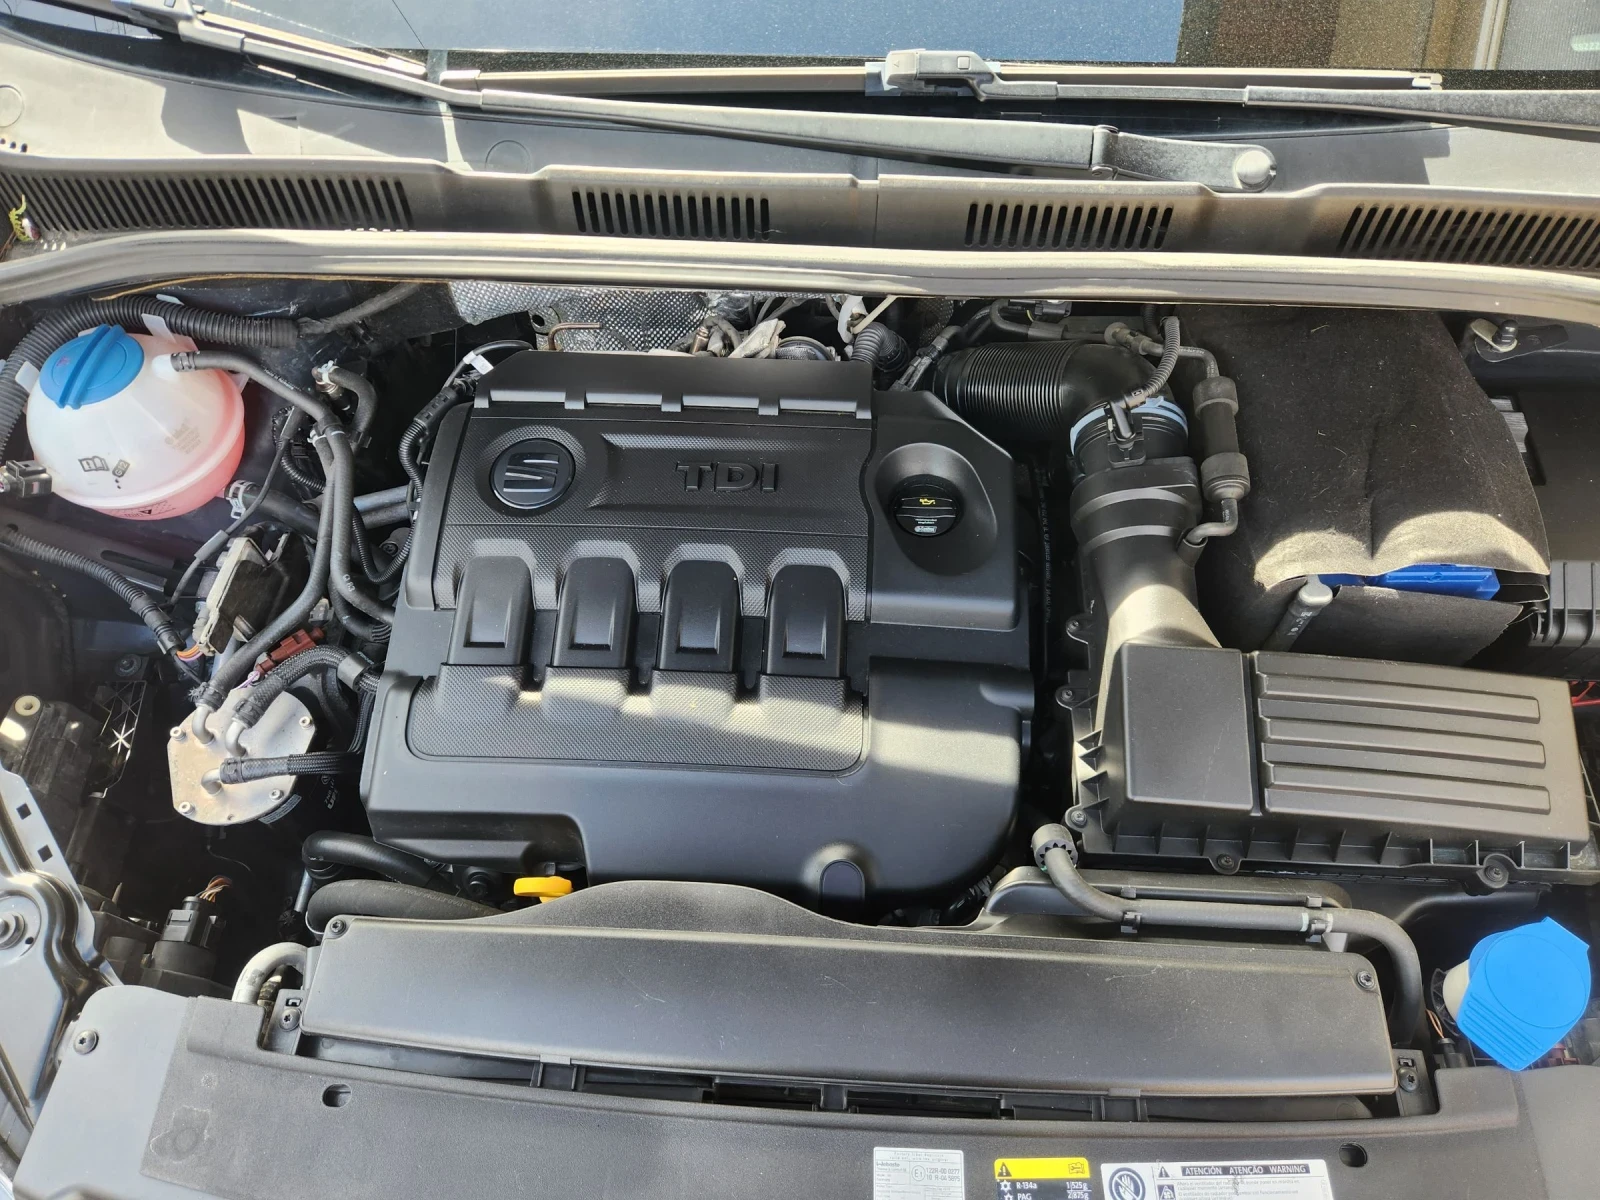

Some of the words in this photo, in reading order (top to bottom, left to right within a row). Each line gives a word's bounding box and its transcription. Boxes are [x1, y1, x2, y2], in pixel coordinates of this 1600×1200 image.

[675, 461, 780, 493] TDI
[1185, 1165, 1223, 1175] ATENCIÓN
[1229, 1164, 1264, 1175] ATENÇÃO
[1269, 1164, 1306, 1174] WARNING
[1016, 1181, 1038, 1189] R-134a
